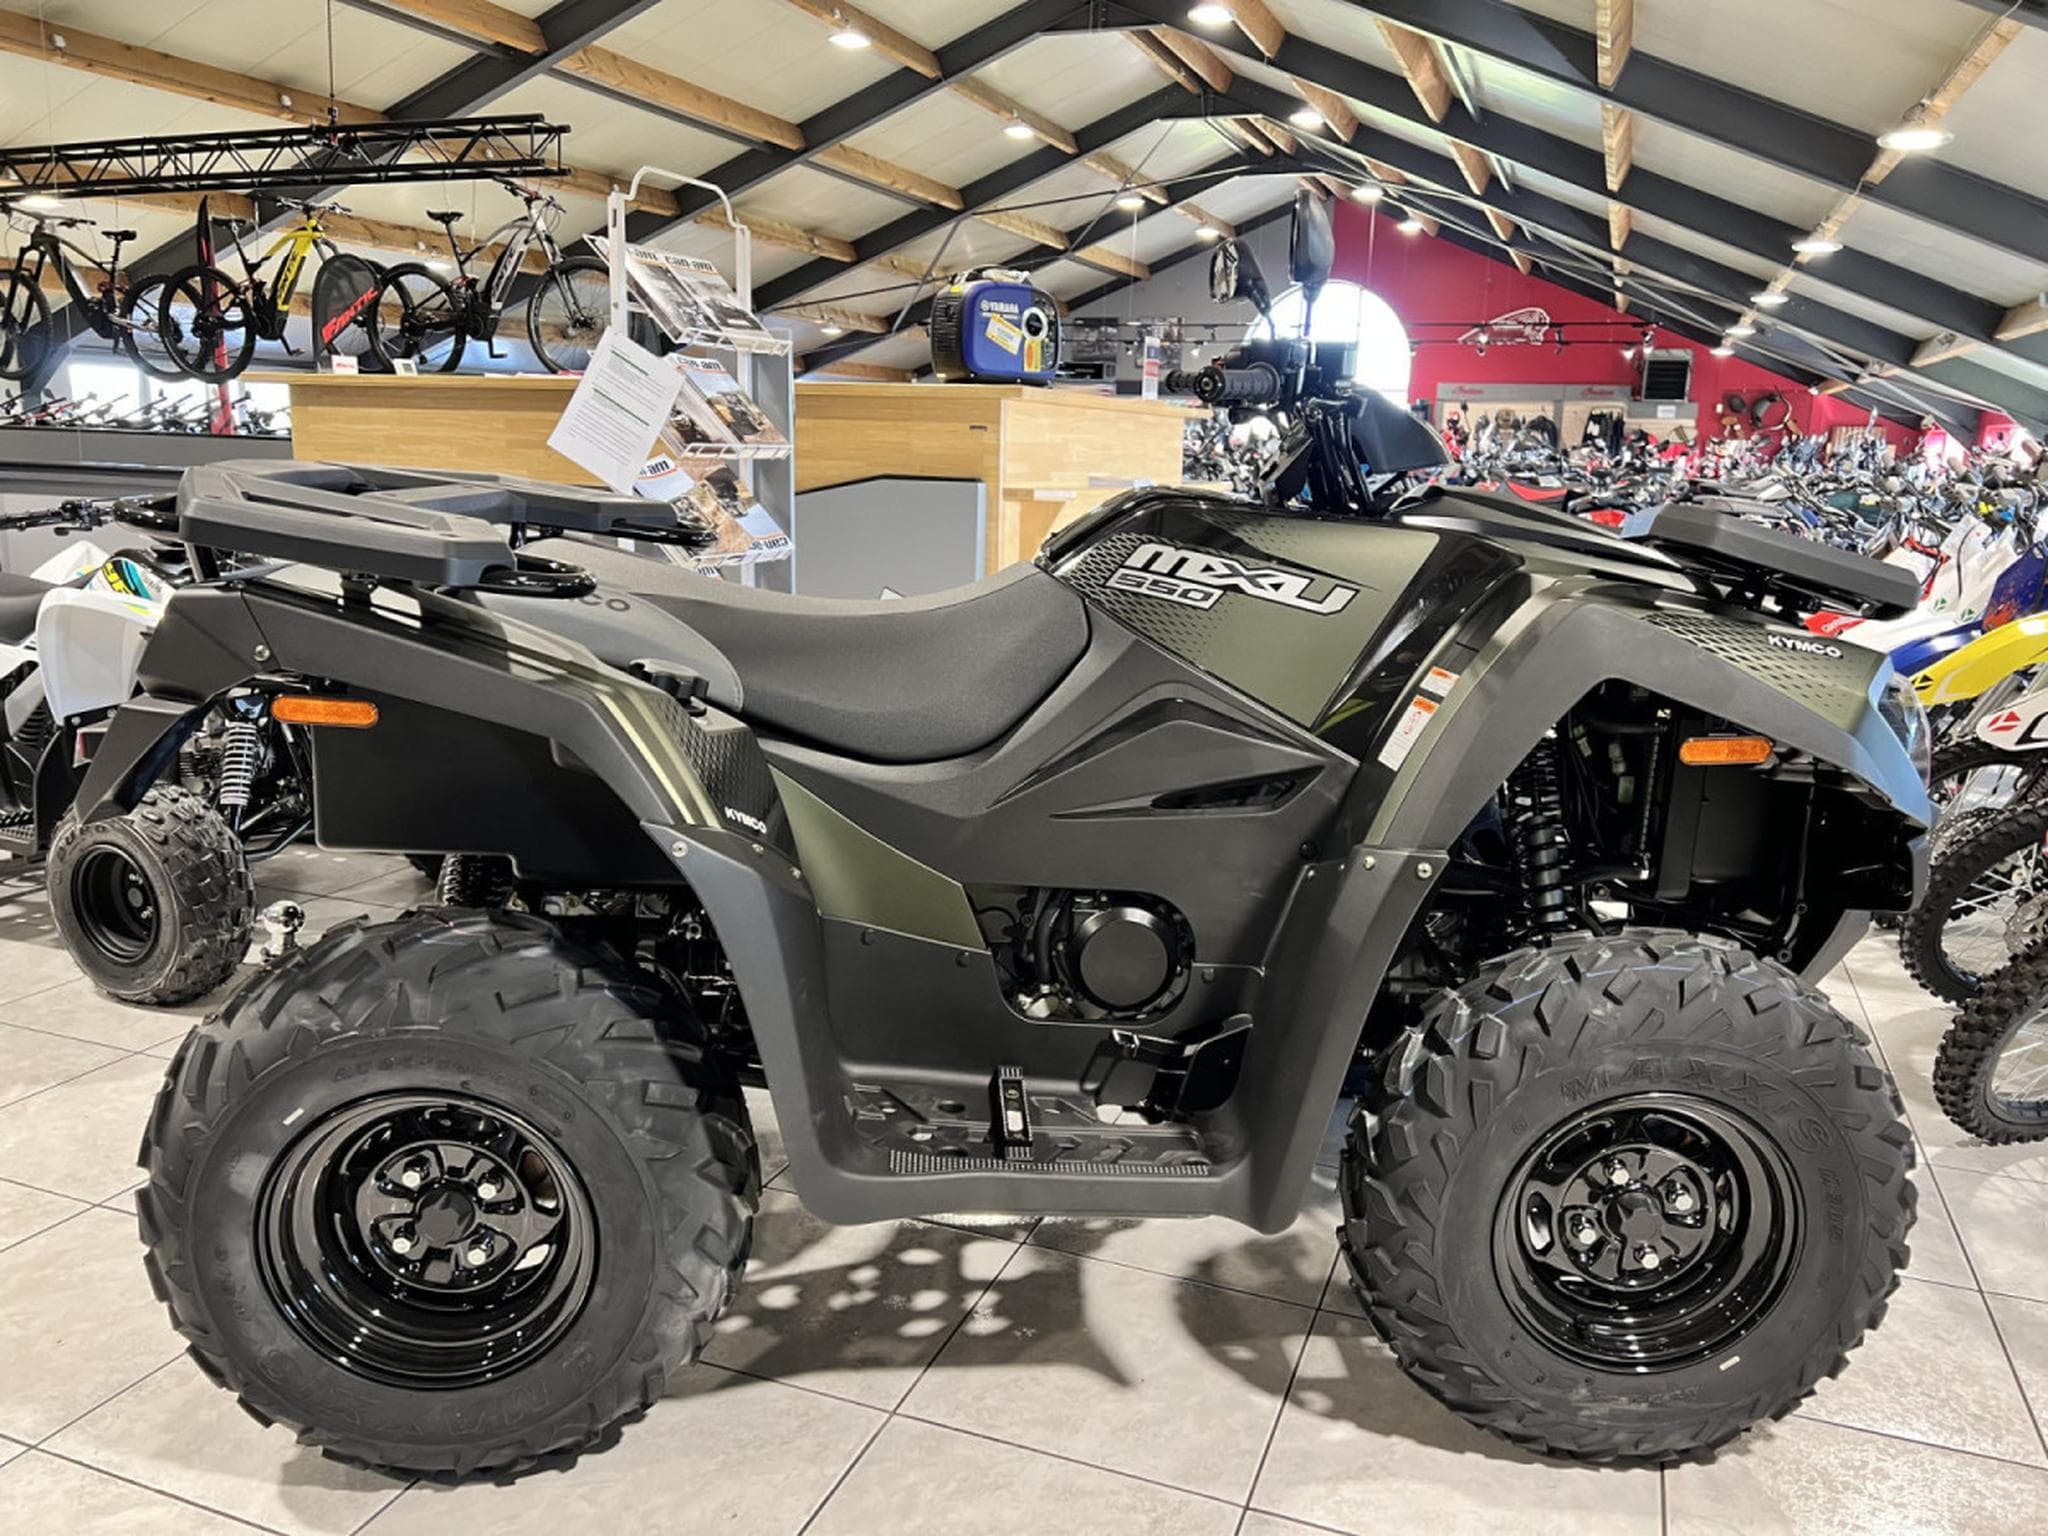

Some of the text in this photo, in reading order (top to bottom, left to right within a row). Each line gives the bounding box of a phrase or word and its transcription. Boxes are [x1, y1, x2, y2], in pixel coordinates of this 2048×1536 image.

[321, 287, 378, 344] FANTIC
[1115, 572, 1216, 602] 550
[1767, 634, 1843, 658] KYMCO
[724, 806, 767, 834] KYMCO
